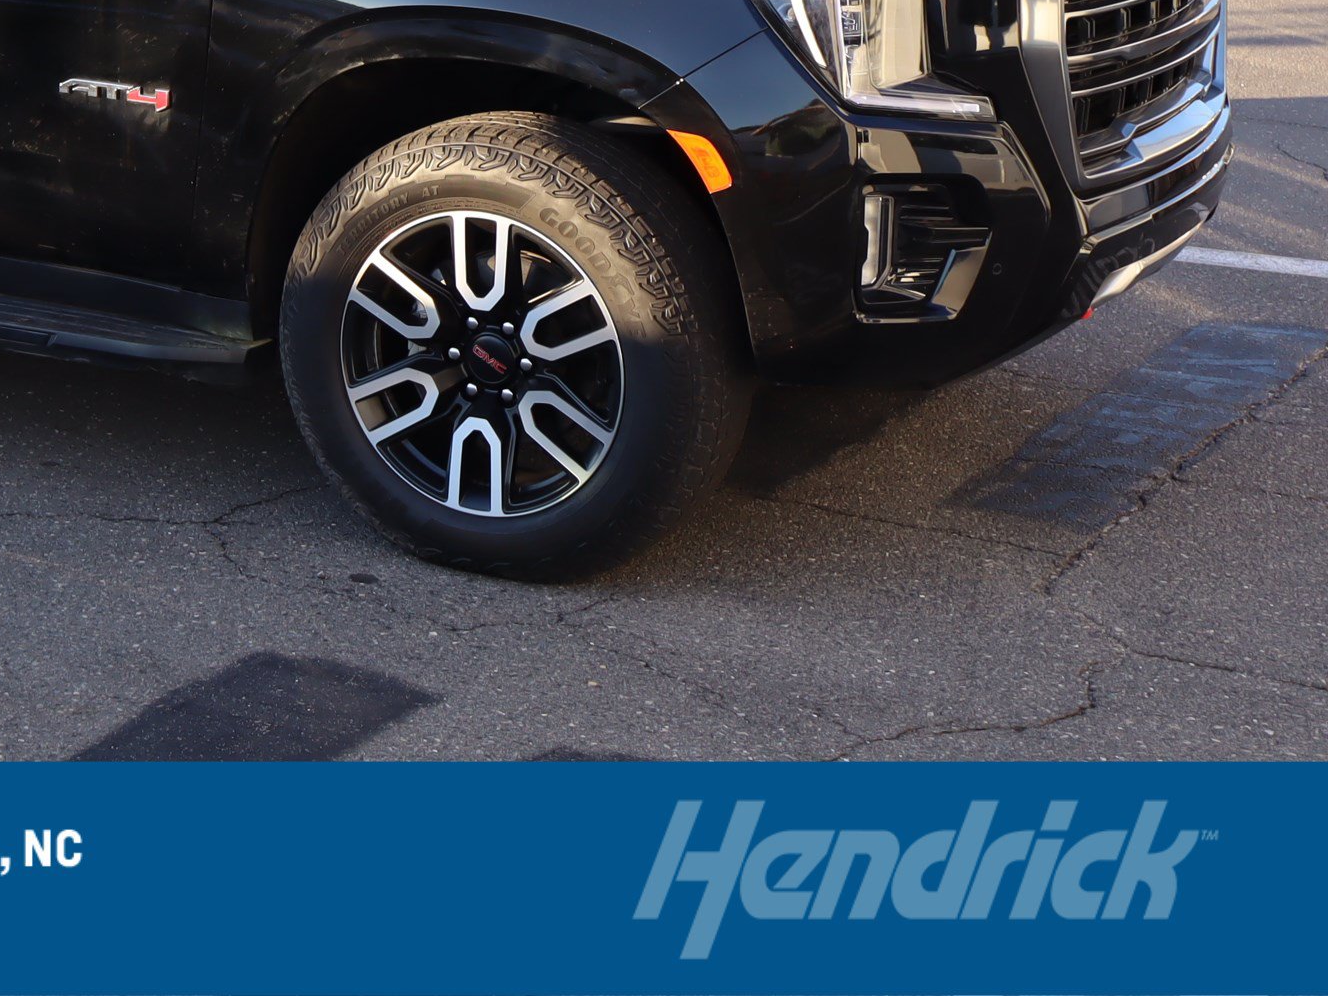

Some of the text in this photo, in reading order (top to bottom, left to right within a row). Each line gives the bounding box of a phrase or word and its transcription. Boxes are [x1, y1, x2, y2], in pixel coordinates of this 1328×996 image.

[58, 77, 170, 112] AT4
[421, 184, 441, 198] AT
[472, 344, 508, 374] GMC
